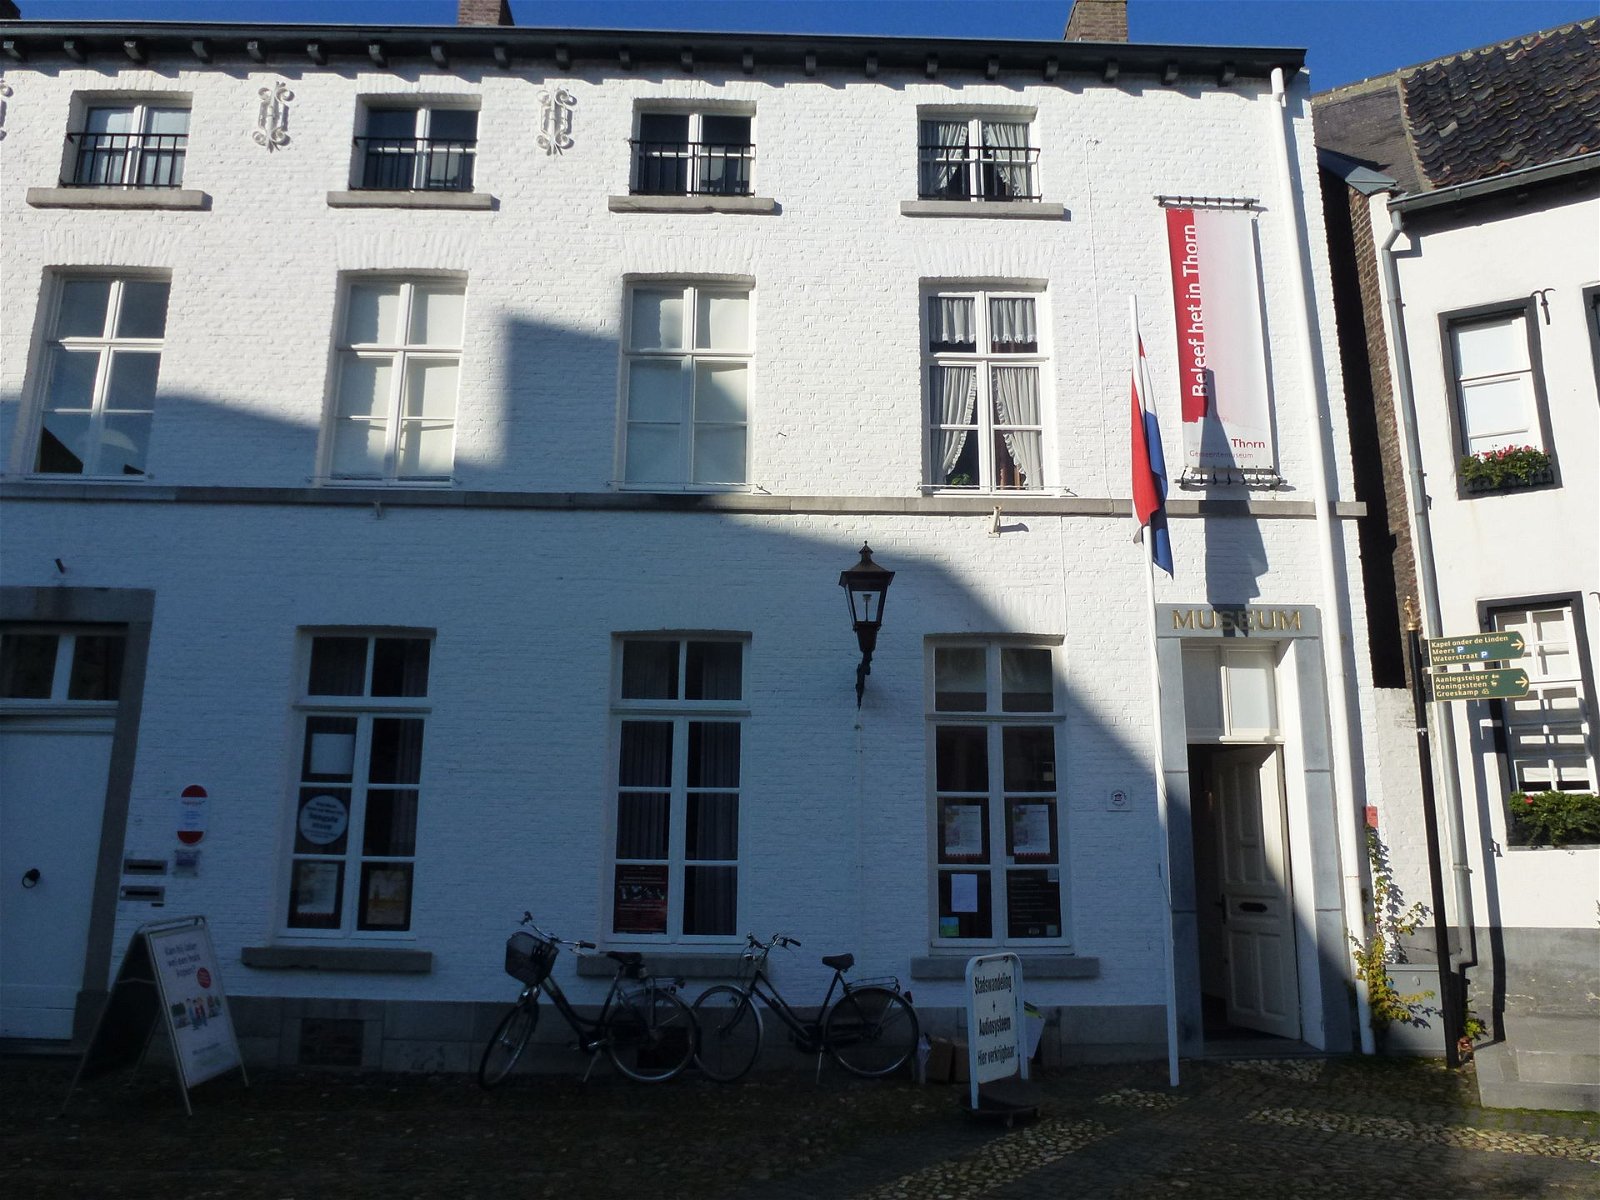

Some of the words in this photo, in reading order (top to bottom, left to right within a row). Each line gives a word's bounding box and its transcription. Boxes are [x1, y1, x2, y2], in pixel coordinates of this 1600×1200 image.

[1183, 224, 1199, 278] Thorn
[1186, 280, 1202, 299] in
[1188, 304, 1203, 337] het
[1191, 338, 1207, 397] Beleef
[1231, 438, 1266, 449] Thorn
[1172, 608, 1302, 631] MUSEUM
[1431, 640, 1451, 649] Kapel
[1451, 638, 1472, 646] onder
[1484, 635, 1508, 643] Linden
[1432, 653, 1478, 662] Waterstraat
[1435, 674, 1489, 684] Aanlegsteiger
[1435, 682, 1487, 691] Koningssteen
[1436, 689, 1479, 697] Groeskamp
[974, 972, 1012, 995] Stadswandeling
[979, 1016, 1011, 1037] Audiosysteem
[978, 1051, 987, 1066] Hier
[987, 1044, 1015, 1064] verkrijgbaar
